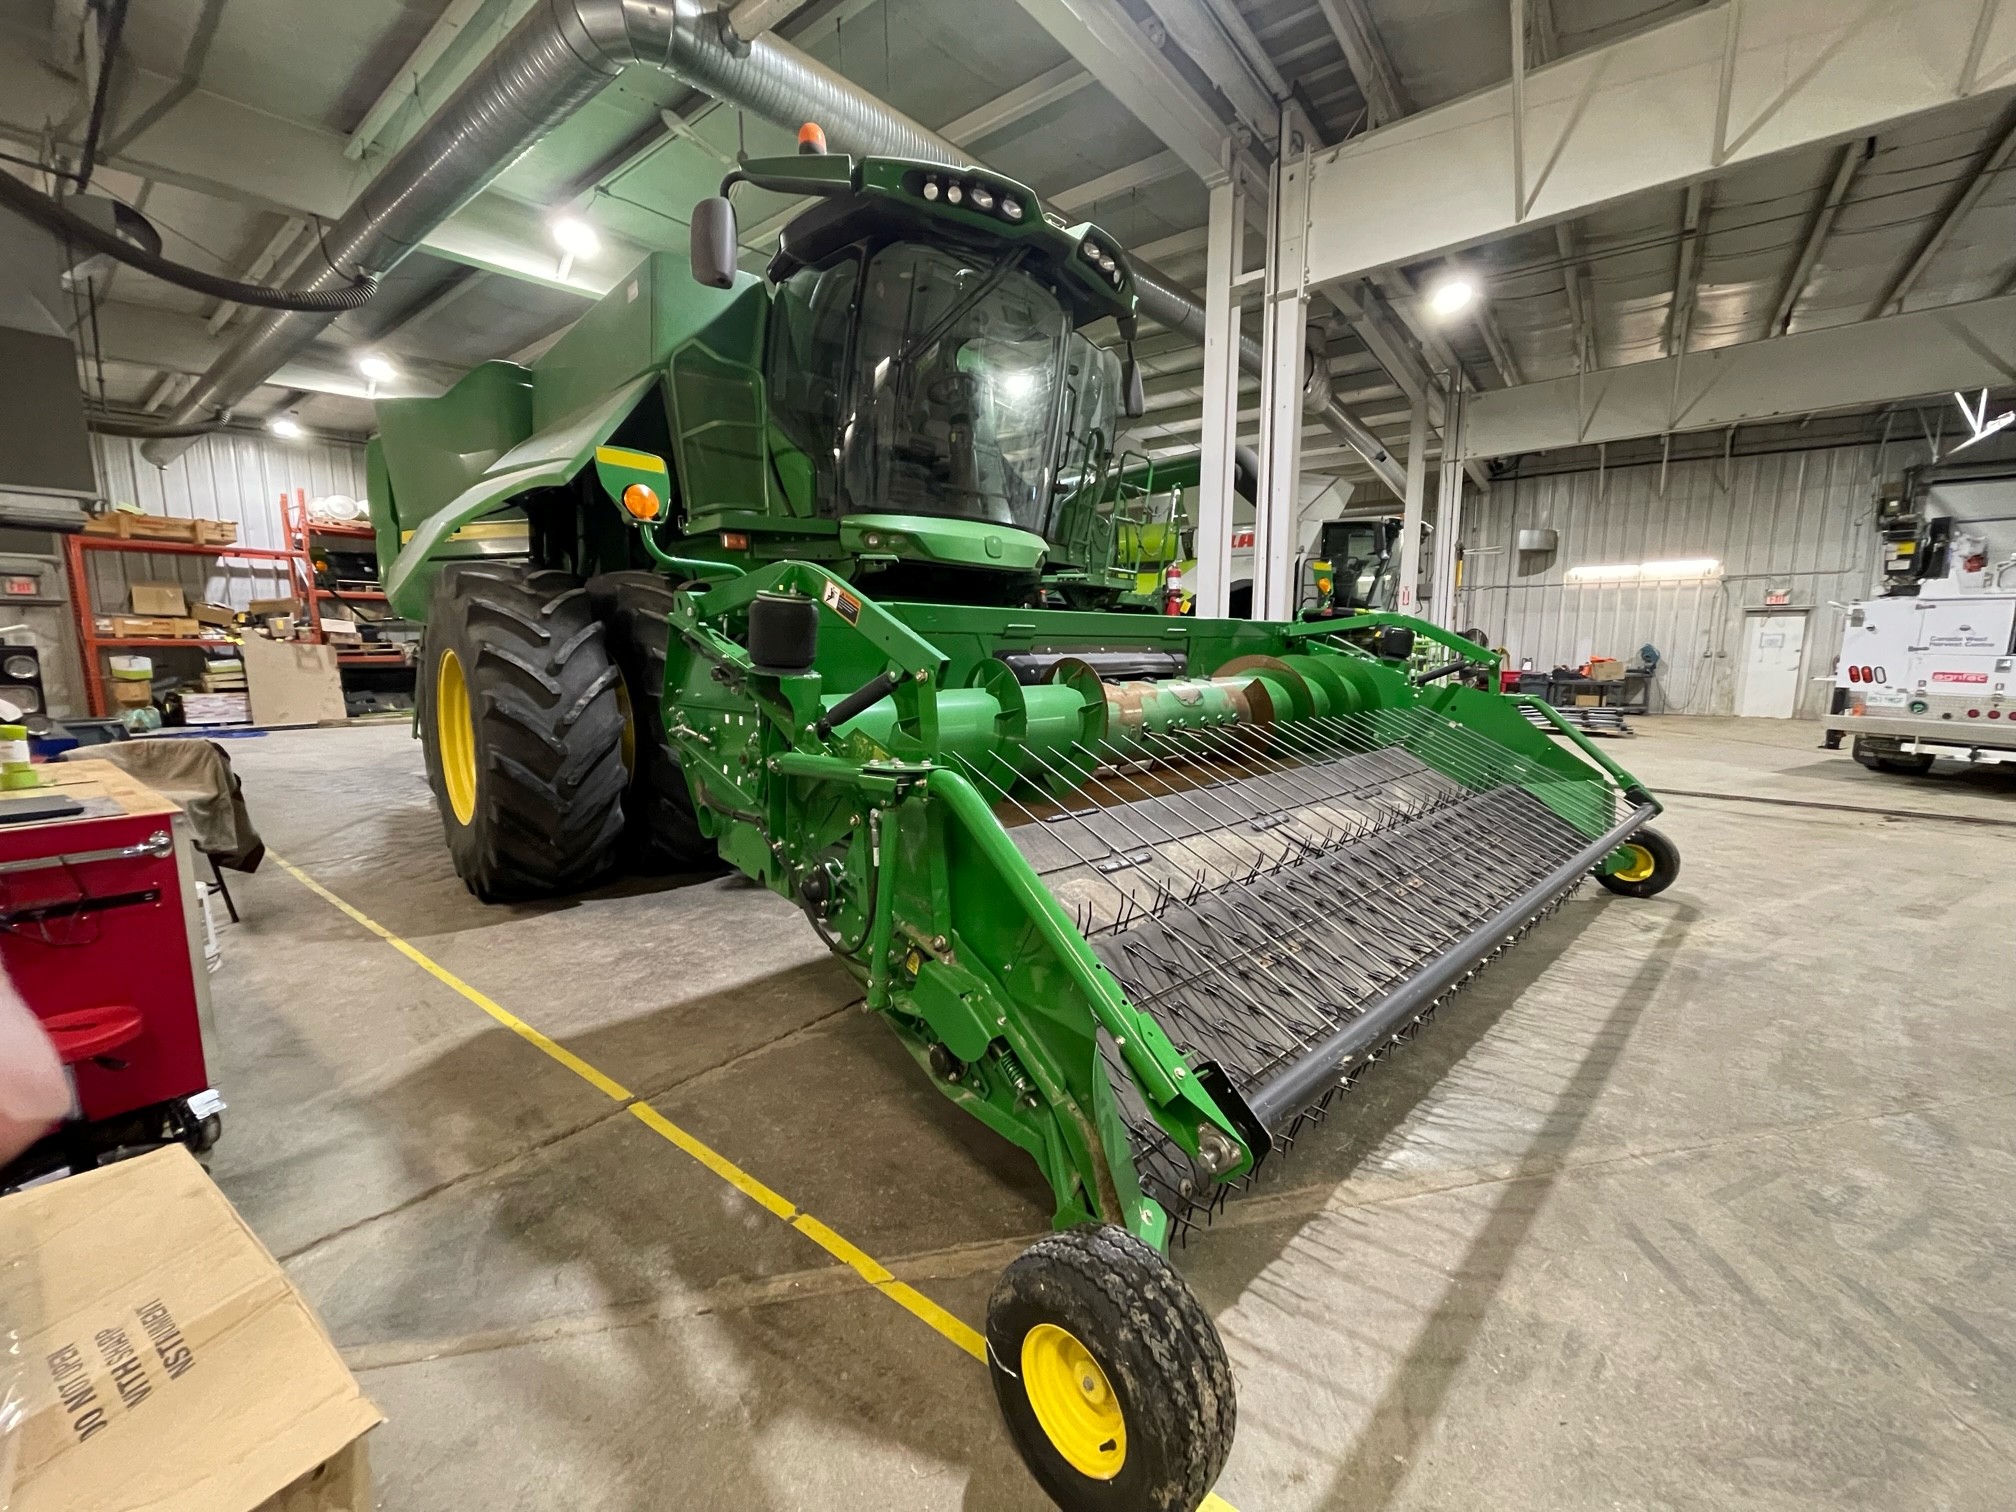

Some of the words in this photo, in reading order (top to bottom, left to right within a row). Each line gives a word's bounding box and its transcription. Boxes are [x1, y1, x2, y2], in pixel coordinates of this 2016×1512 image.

[94, 1327, 135, 1366] SHARP
[134, 1298, 196, 1380] NSTRUMENT
[46, 1342, 83, 1382] OPEN
[58, 1373, 97, 1413] NOT
[73, 1407, 108, 1443] DO
